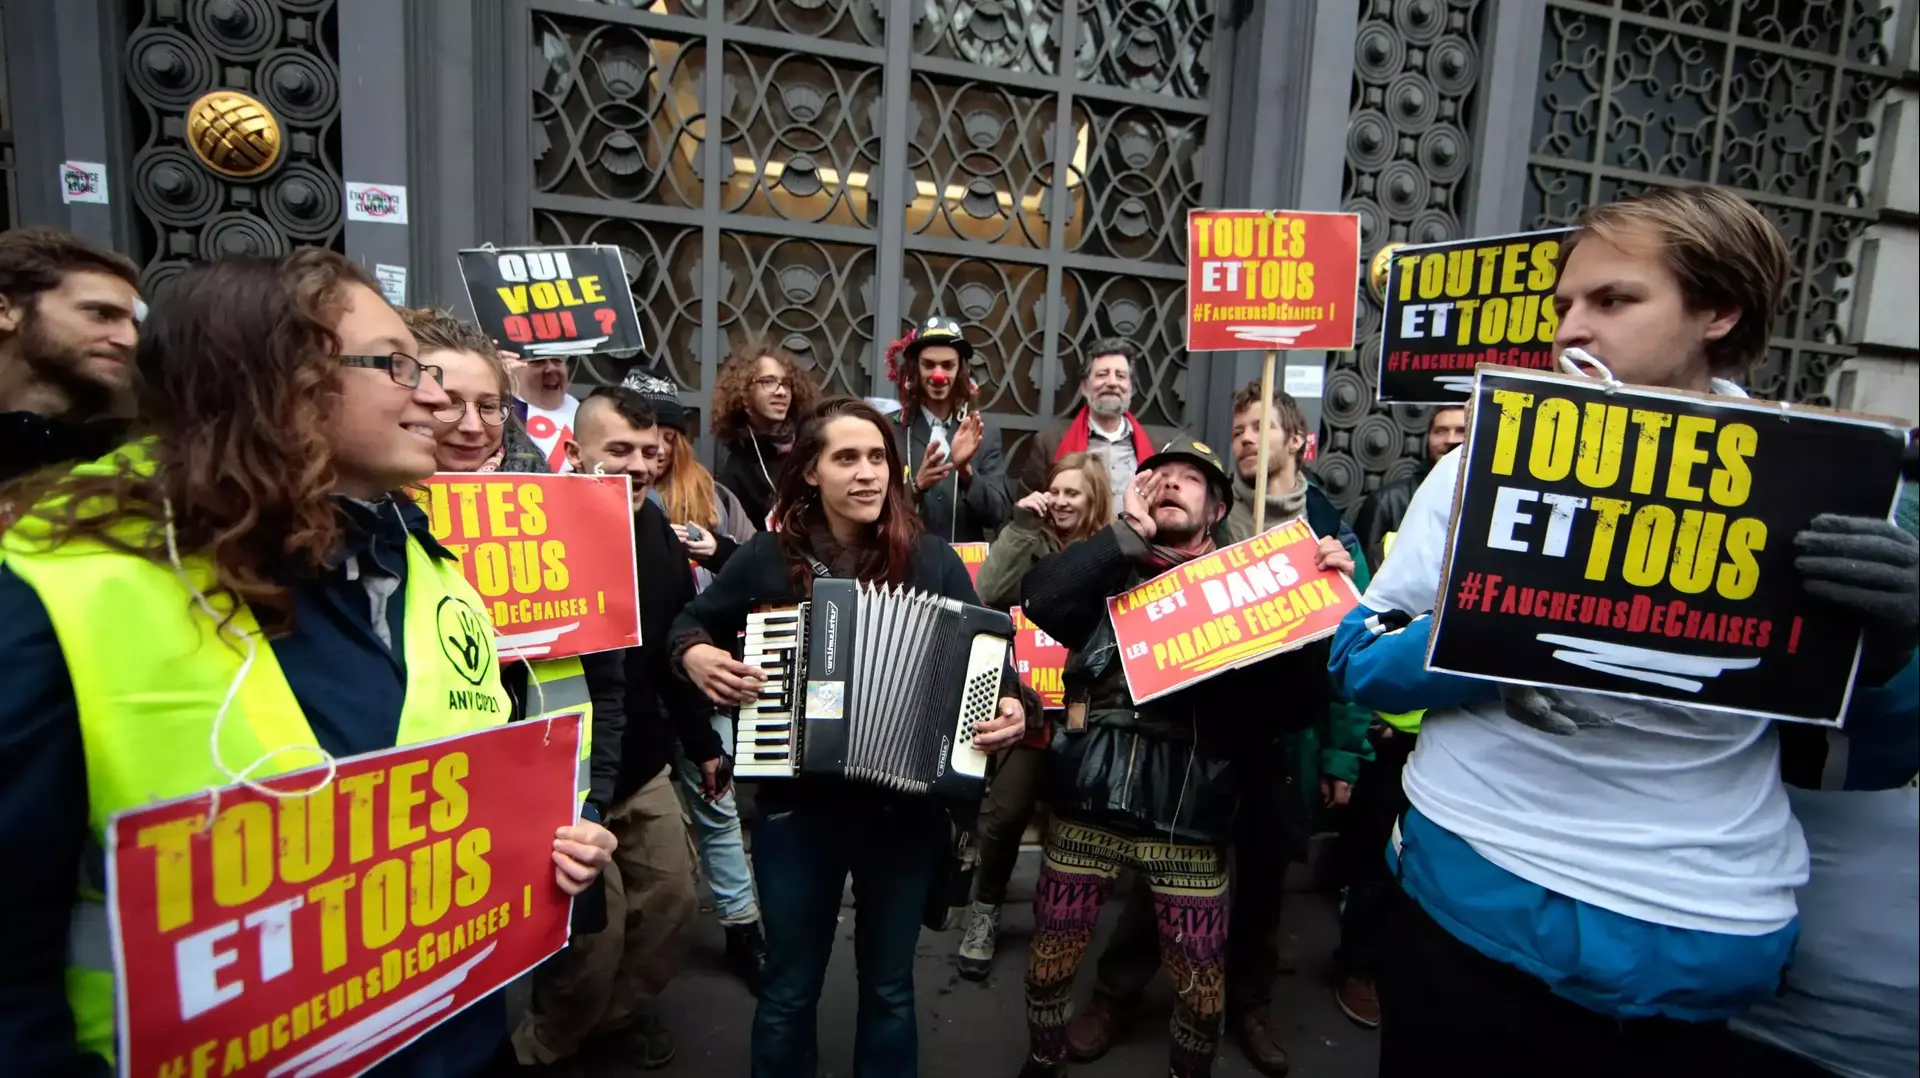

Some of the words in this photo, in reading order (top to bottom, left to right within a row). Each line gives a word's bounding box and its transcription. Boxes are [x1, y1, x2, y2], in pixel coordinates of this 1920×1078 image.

[498, 252, 574, 282] QUI
[1194, 217, 1306, 258] TOUTES
[497, 275, 606, 315] VOLE
[1398, 241, 1560, 301] TOUTES
[503, 311, 578, 342] QUI
[1491, 389, 1759, 507] TOUTES
[1116, 572, 1183, 615] L'ARGENT
[1183, 554, 1226, 584] POUR
[1226, 546, 1249, 569] LE
[1249, 521, 1312, 558] CLIMAT
[1145, 589, 1188, 622] EST
[1201, 552, 1300, 615] DANS
[1126, 641, 1149, 660] LES
[1152, 614, 1242, 671] PARADIS
[1243, 578, 1341, 635] FISCAUX
[137, 751, 470, 934] TOUTES
